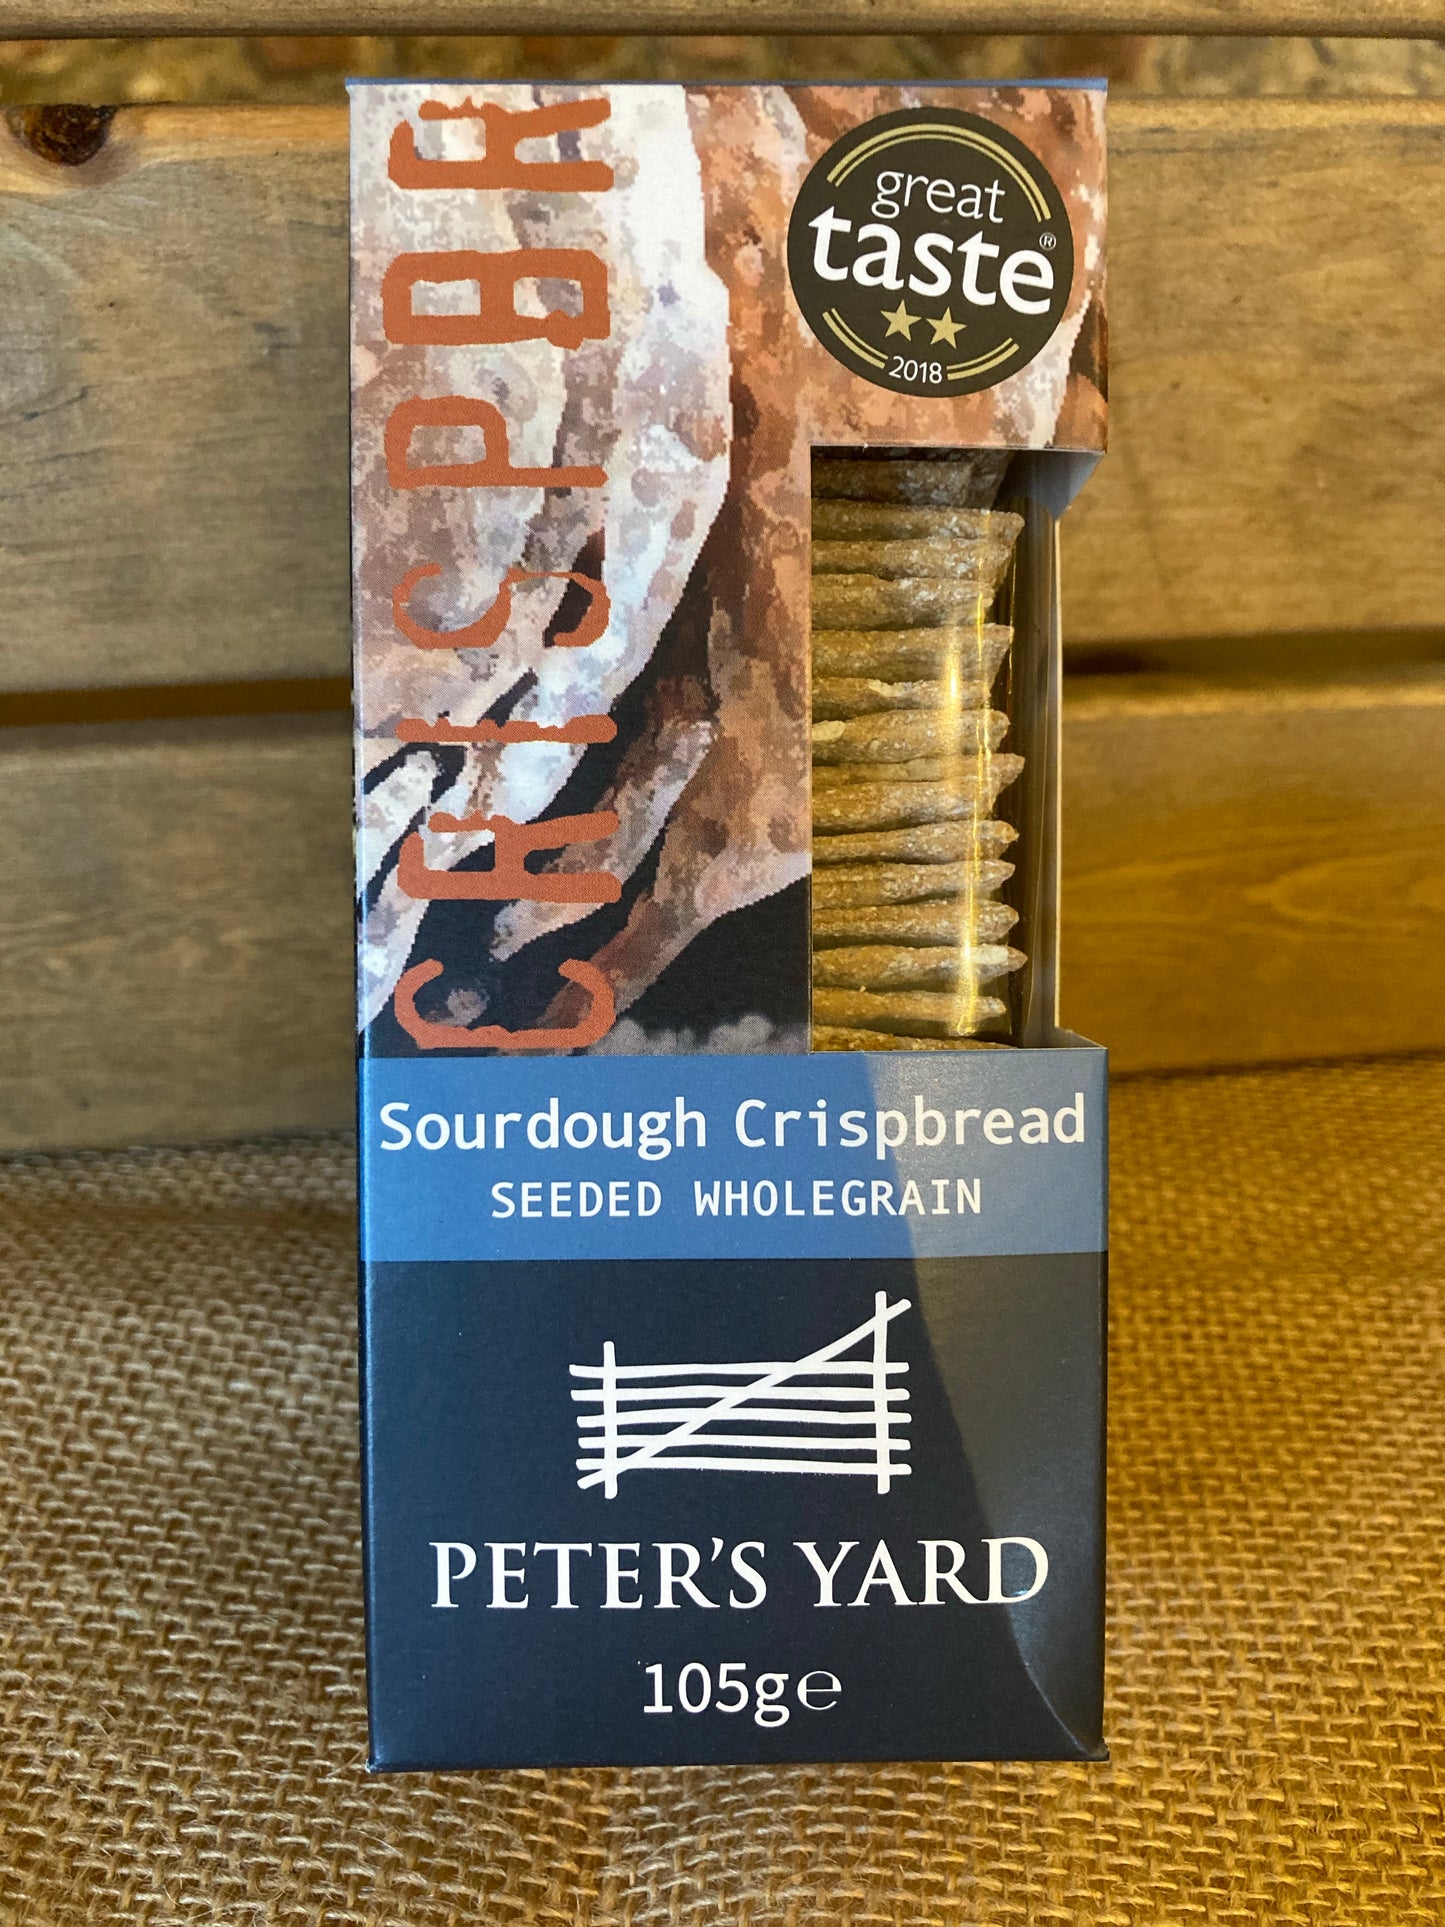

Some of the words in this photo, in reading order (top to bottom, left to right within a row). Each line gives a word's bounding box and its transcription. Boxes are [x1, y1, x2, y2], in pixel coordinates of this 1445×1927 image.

[871, 171, 1005, 223] great
[808, 205, 1054, 315] taste
[888, 356, 944, 384] 2018
[382, 97, 622, 1050] CRISPBR
[379, 1098, 708, 1160] Sourdough
[734, 1093, 1087, 1160] Crispbread
[490, 1180, 663, 1219] SEEDED
[694, 1178, 983, 1217] WHOLEGRAIN
[429, 1537, 768, 1610] PETER'S
[792, 1536, 1051, 1607] YARD
